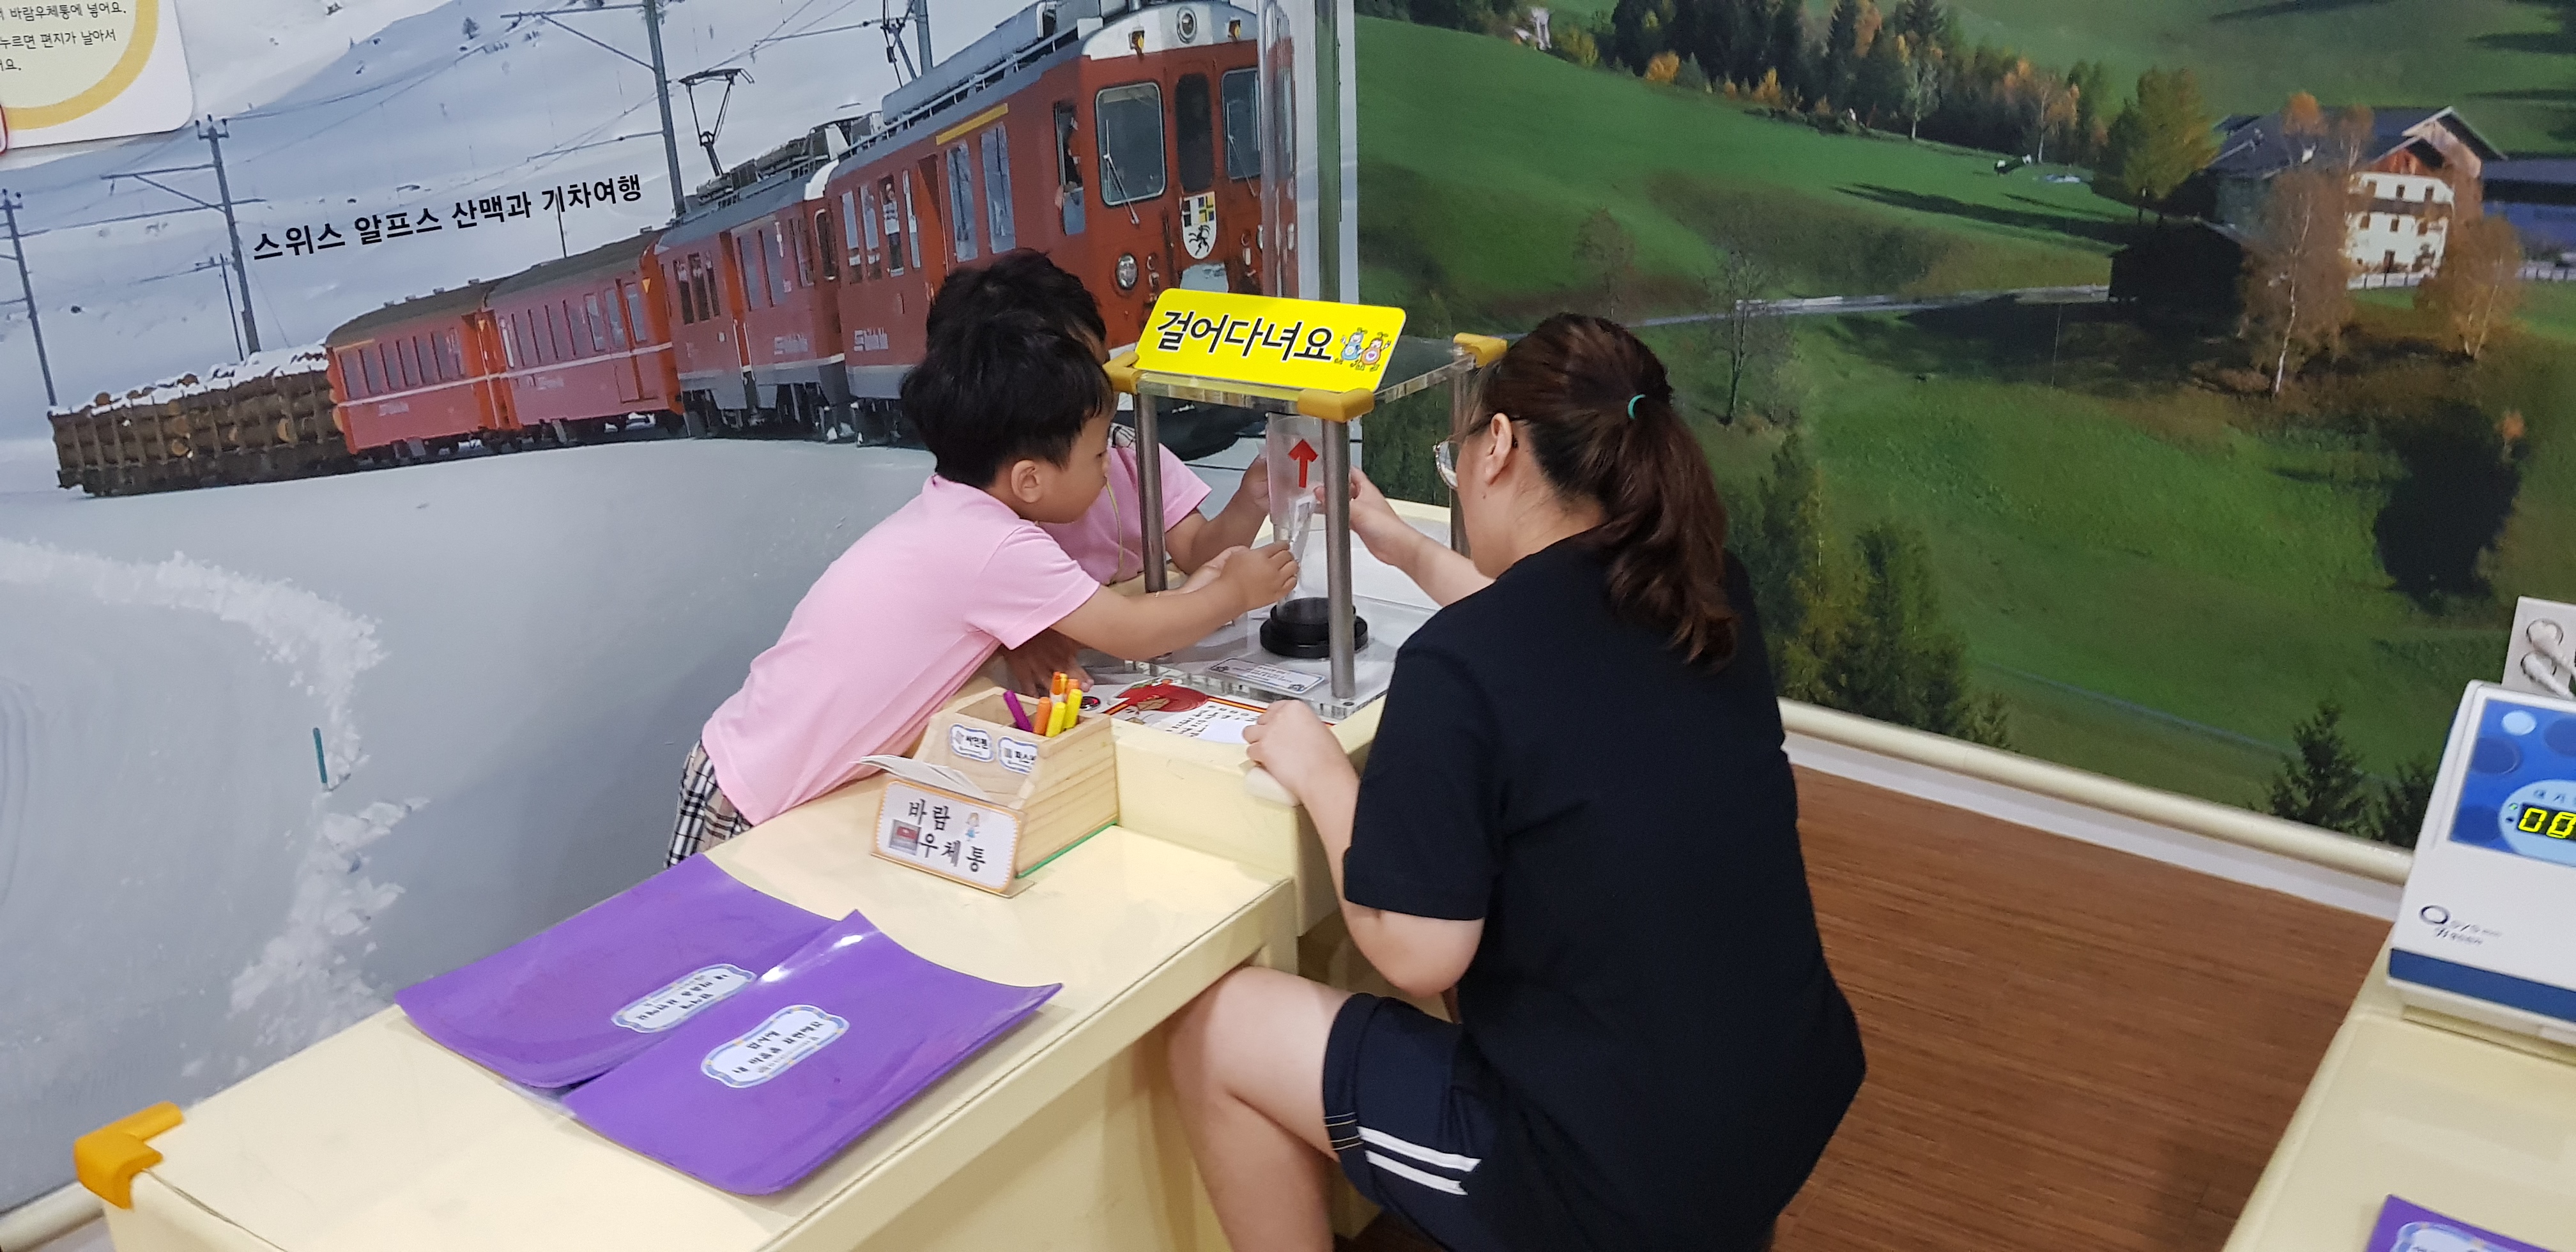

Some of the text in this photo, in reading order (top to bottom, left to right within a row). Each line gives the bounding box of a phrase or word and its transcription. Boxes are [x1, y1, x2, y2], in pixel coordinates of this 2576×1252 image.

[10, 4, 83, 22] 바람우체통에
[87, 1, 126, 19] 넣어요.
[40, 32, 76, 49] 편지가
[81, 28, 116, 45] 날아서
[253, 174, 642, 260] 스위스 알프스 산맥과 기차여행
[1156, 310, 1333, 362] 걸어다녀요
[907, 798, 951, 832] 바람
[917, 832, 987, 873] 우체통
